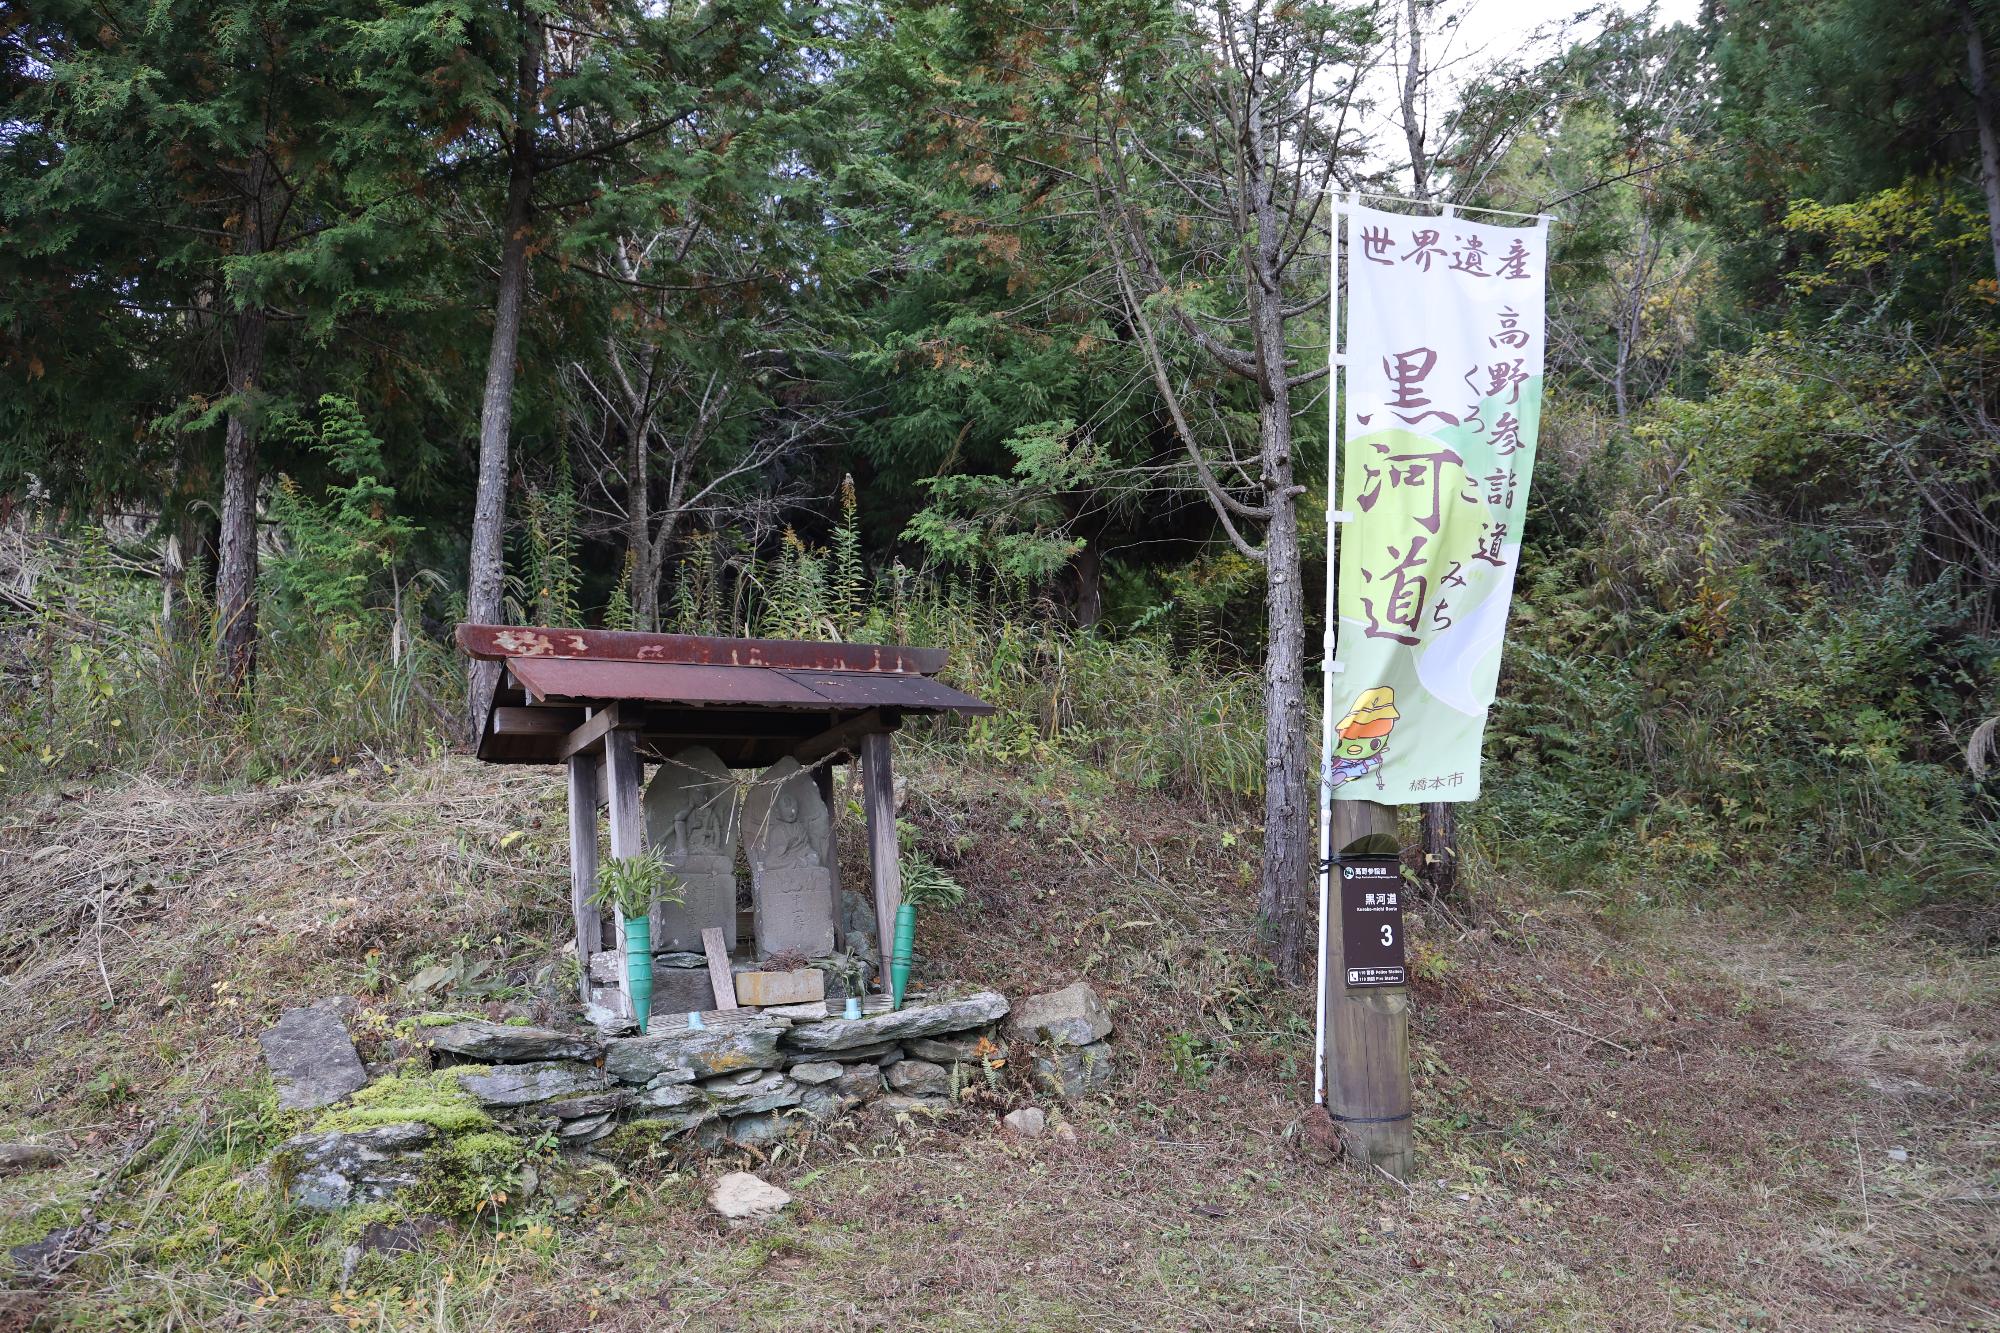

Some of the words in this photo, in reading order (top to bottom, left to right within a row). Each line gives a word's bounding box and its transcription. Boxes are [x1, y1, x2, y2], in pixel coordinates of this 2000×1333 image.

[1360, 225, 1531, 280] 世界遺産
[1471, 305, 1530, 567] 高野参詣道
[1357, 346, 1463, 646] 黒河道
[1408, 771, 1465, 792] 橋本市
[1365, 892, 1398, 905] 黒河道
[1380, 924, 1394, 947] 3
